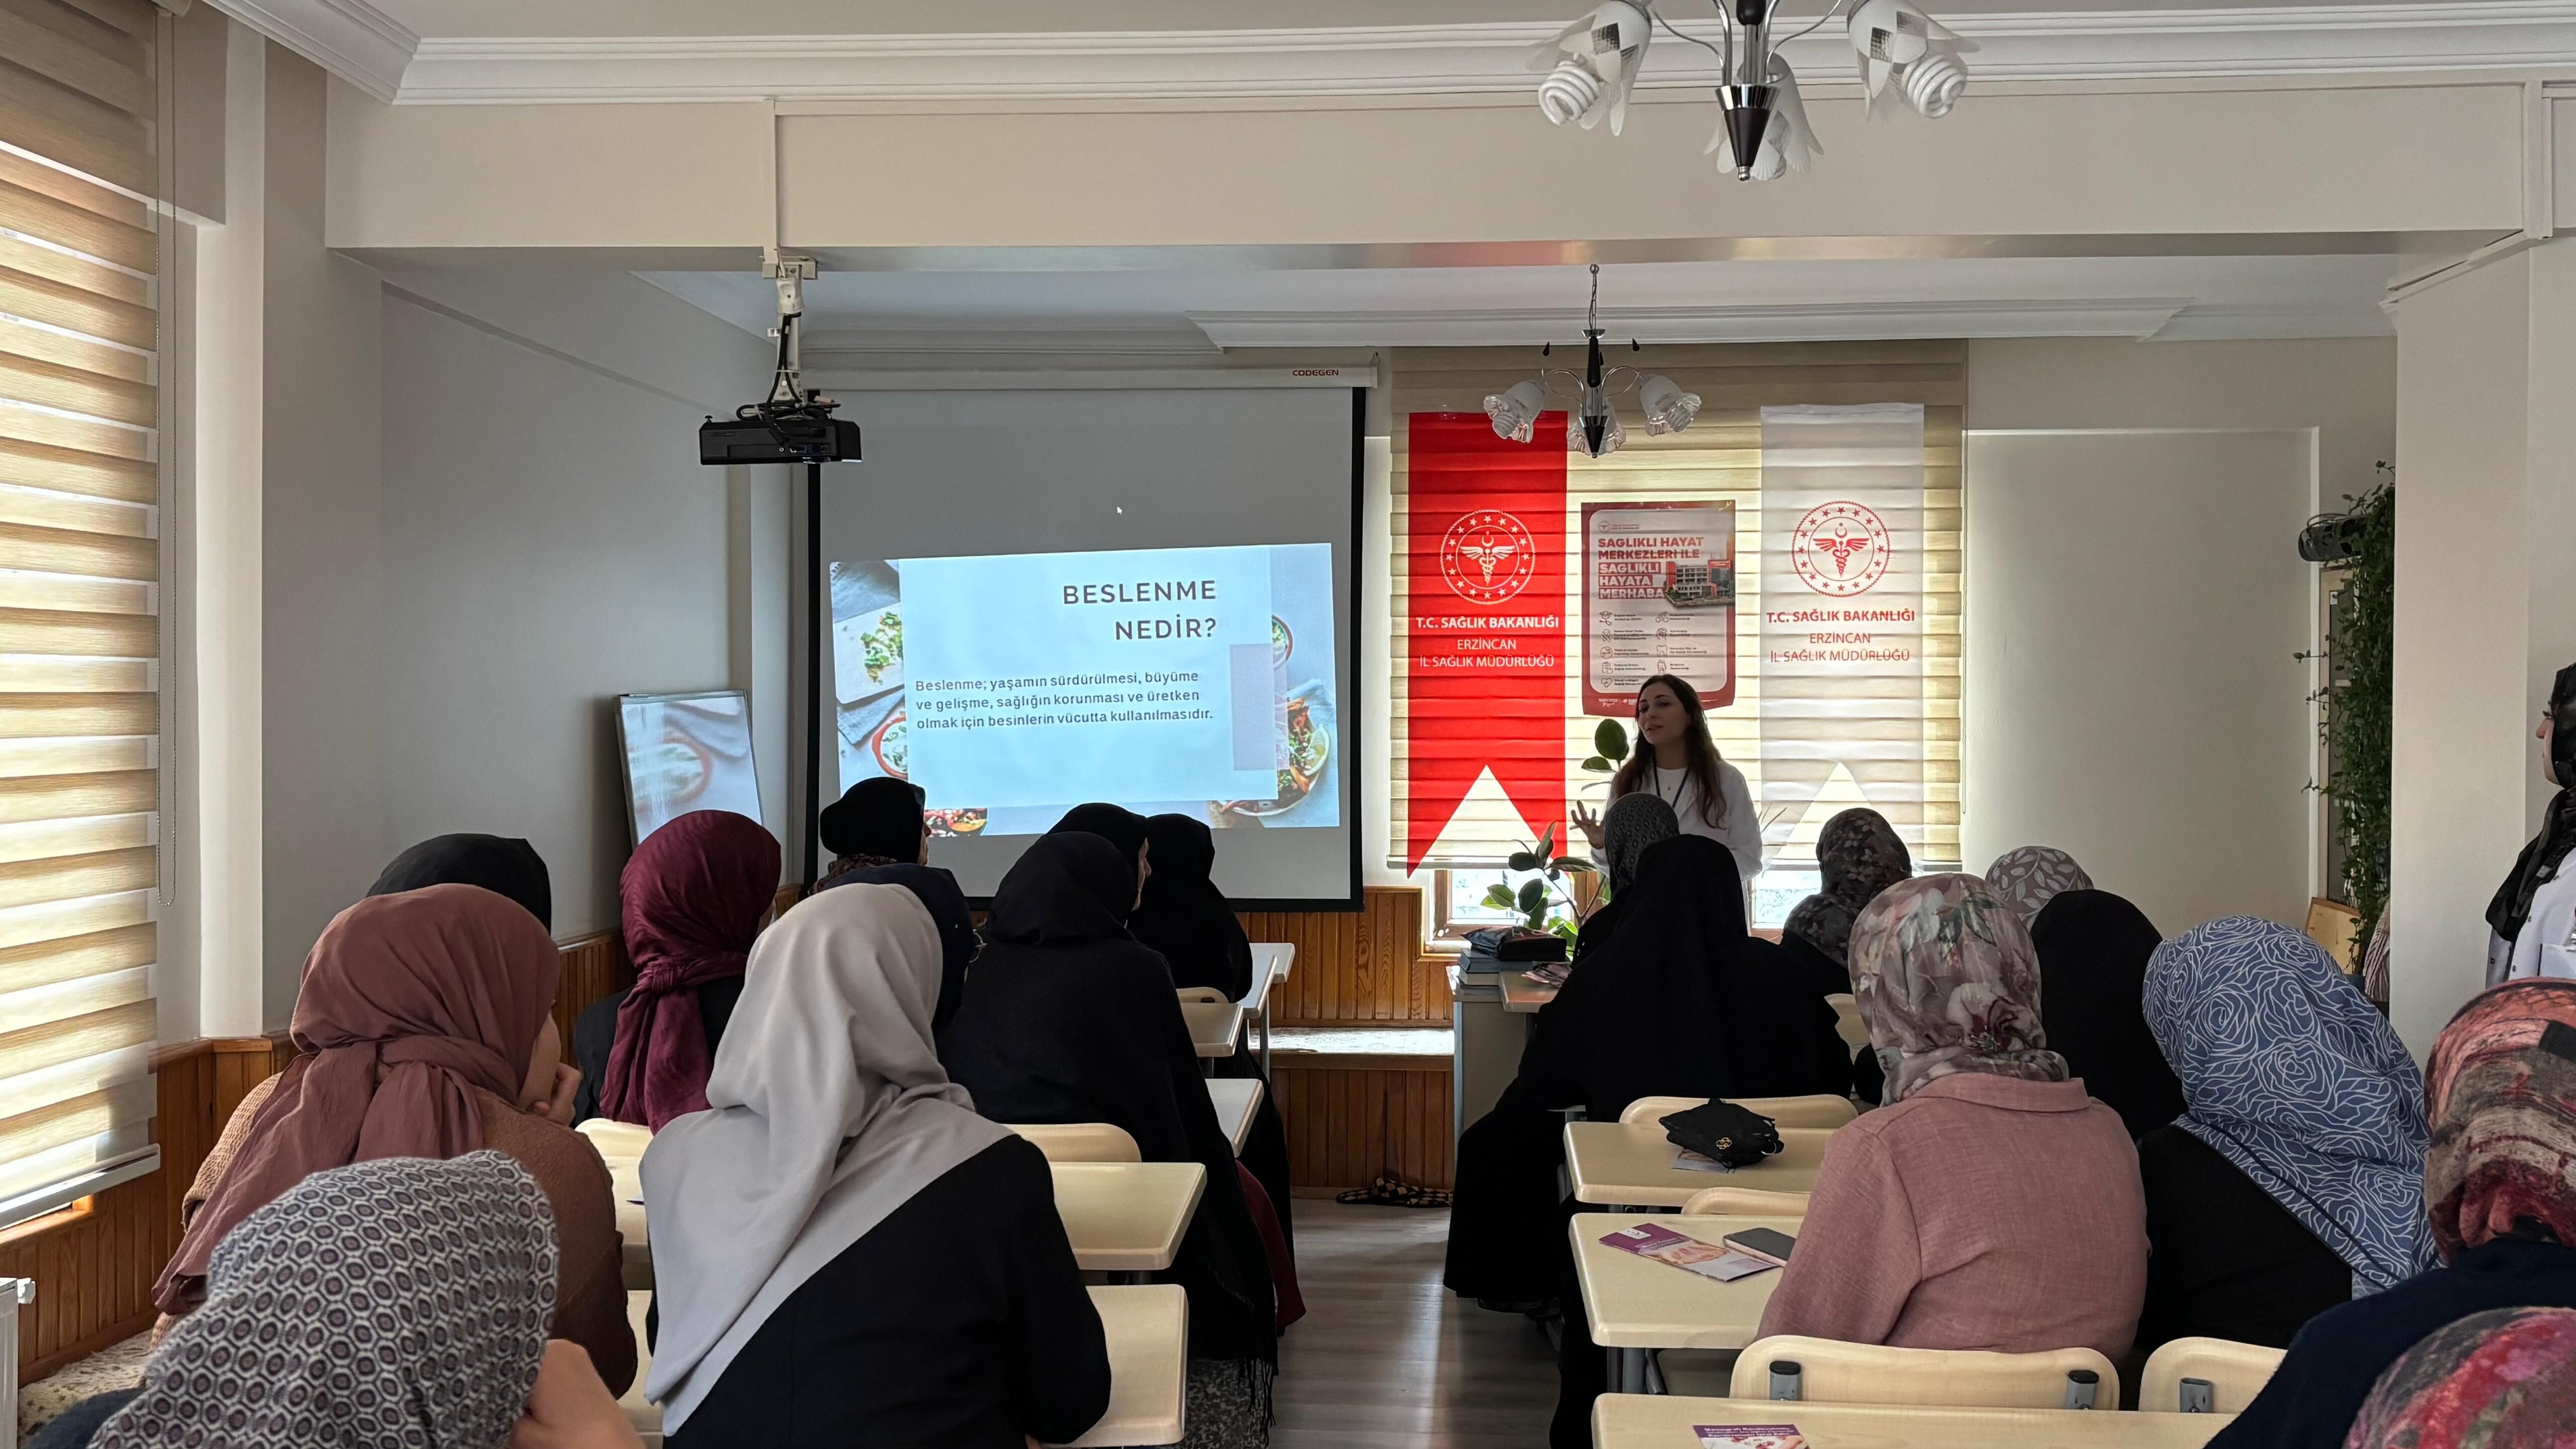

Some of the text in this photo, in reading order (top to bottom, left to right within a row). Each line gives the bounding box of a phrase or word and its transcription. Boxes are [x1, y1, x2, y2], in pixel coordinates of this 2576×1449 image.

[1661, 537, 1704, 547] HAYAT
[1599, 576, 1651, 586] HAYATA
[1063, 580, 1217, 605] BESLENME
[1600, 588, 1665, 598] MERHABA
[1416, 615, 1559, 628] T.C. SAĞLIK BAKANLIĞI
[1766, 608, 1915, 623] T.C. SAĞLIK BAKANLIĞI
[1115, 614, 1217, 640] NEDİR?
[1457, 637, 1516, 650] ERZİNCAN
[1810, 631, 1871, 644] ERZİNCAN
[1420, 654, 1554, 667] İL SAĞLIK MÜDÜRLÜĞÜ
[1770, 649, 1910, 663] İL SAĞLIK MÜDÜRLÜĞÜ
[916, 672, 1198, 691] Beslenme; yaşamın sürdürülmesi, büyüme
[916, 690, 1199, 712] ve gelişme, sağlığın korunması ve üretken
[917, 708, 1213, 730] olmak için besinlerin vücutta kullanılmasıdır.
